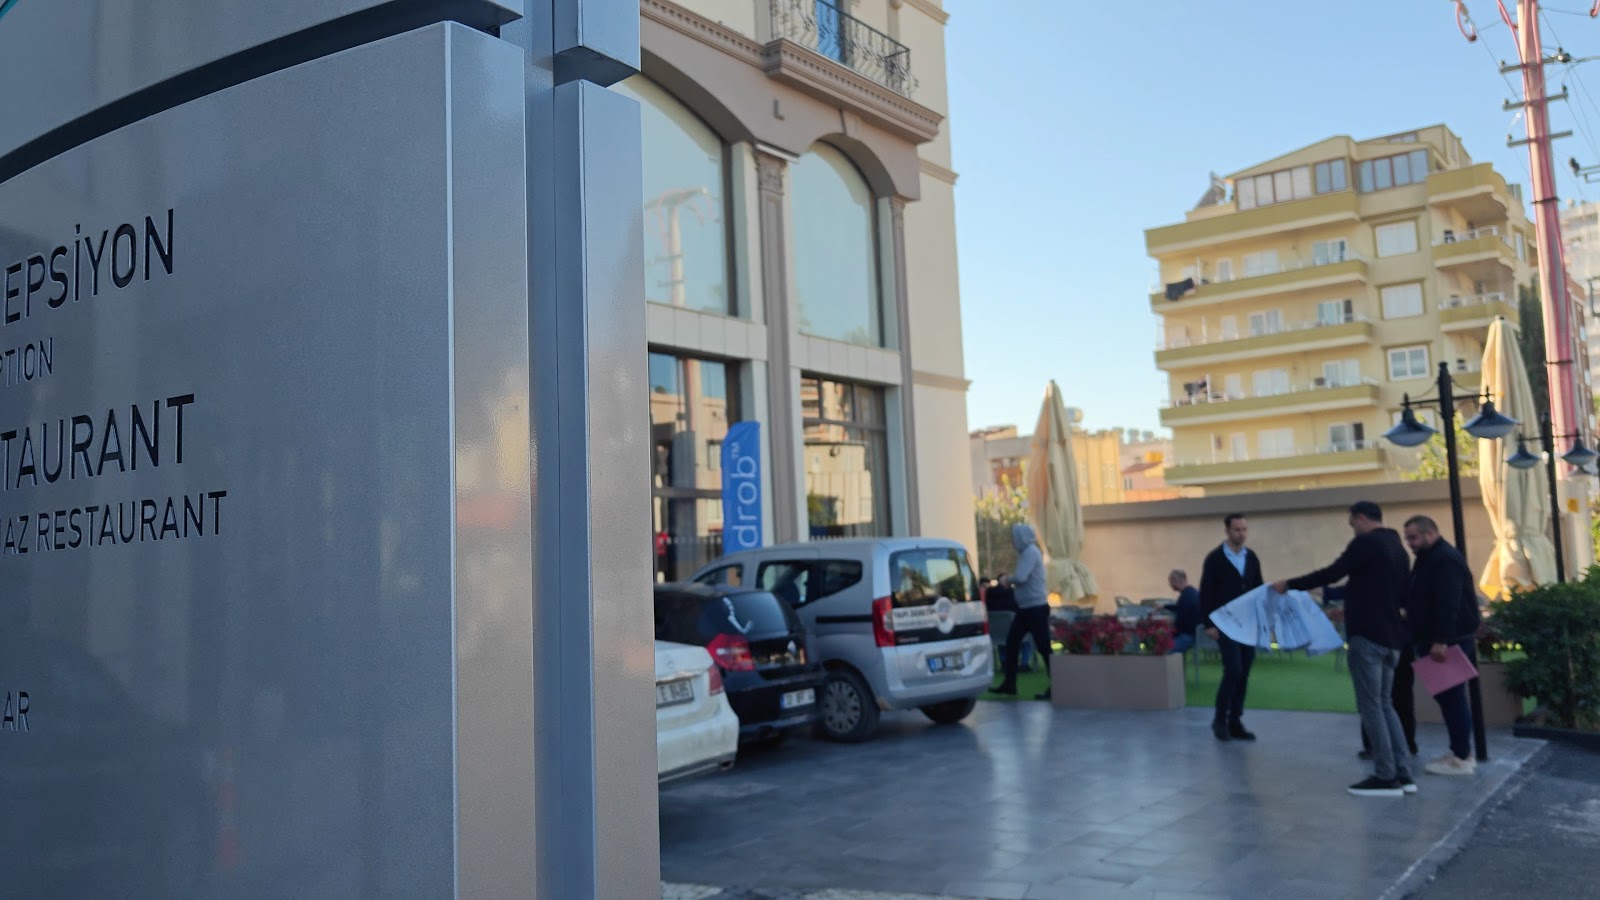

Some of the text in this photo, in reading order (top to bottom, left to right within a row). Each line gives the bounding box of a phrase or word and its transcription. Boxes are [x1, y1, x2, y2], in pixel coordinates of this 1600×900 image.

[4, 208, 174, 326] EPSİYON
[0, 337, 53, 387] TION
[0, 393, 195, 491] TAURANT
[0, 491, 227, 555] AZ RESTAURANT
[731, 456, 758, 547] drob
[1, 690, 30, 731] AR
